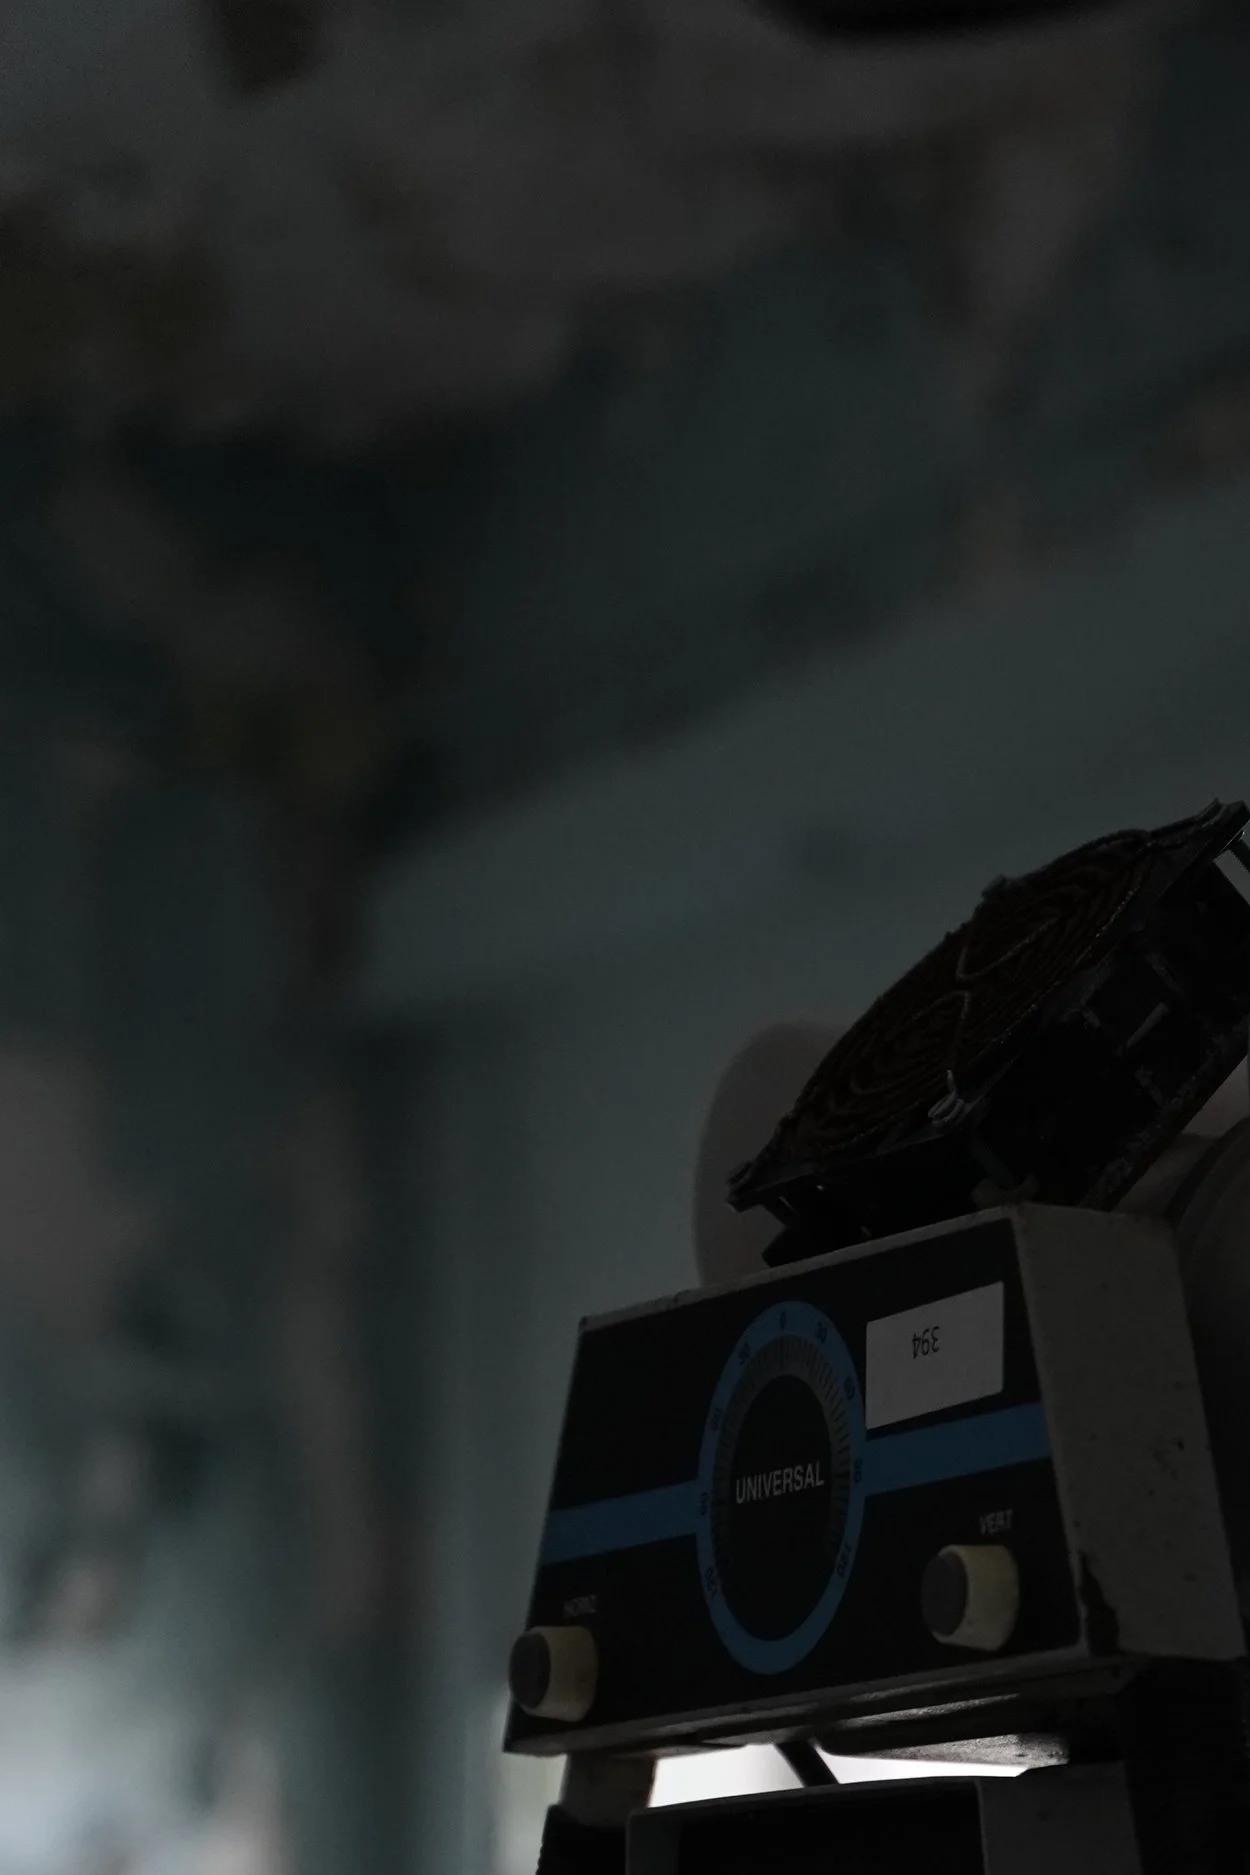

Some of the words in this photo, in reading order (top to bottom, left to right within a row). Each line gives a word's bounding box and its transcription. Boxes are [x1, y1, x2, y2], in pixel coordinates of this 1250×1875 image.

[912, 1325, 941, 1359] 394
[736, 1460, 825, 1504] UNIVERSAL
[979, 1508, 1013, 1536] VERT
[836, 1544, 852, 1577] 120
